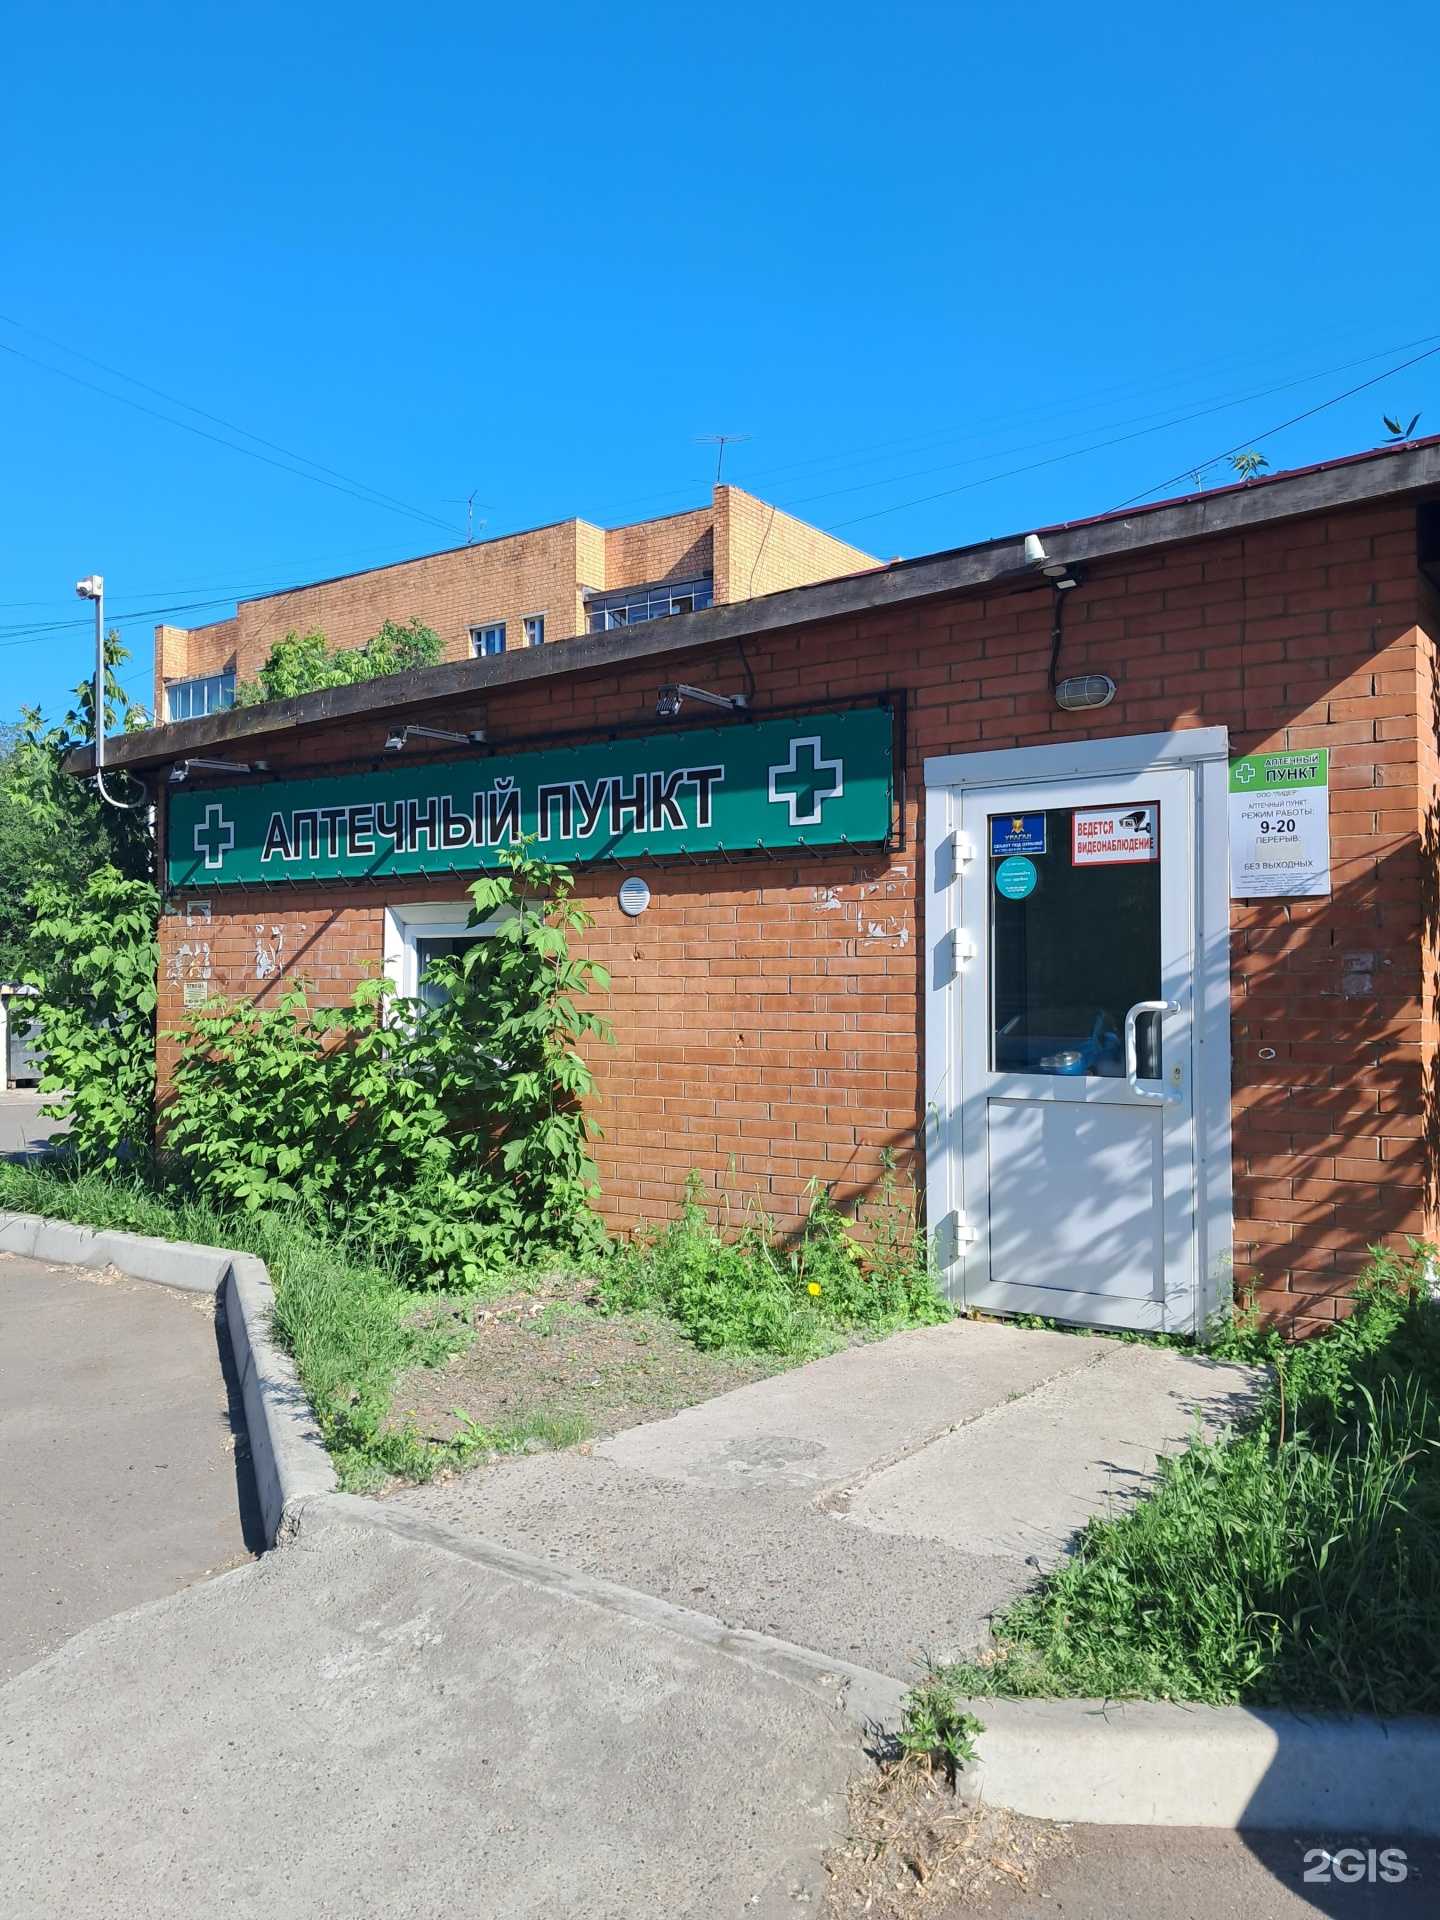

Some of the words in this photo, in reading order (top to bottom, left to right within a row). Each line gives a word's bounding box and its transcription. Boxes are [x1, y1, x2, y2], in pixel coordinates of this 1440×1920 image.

[1264, 754, 1319, 767] АПТЕЧНЫЙ
[1265, 767, 1318, 783] ПУНКТ
[1285, 799, 1307, 807] ПУНКТ
[261, 776, 522, 863] АПТЕЧНЫЙ
[537, 764, 726, 842] ПУНКТ
[1241, 810, 1274, 819] РЕЖИМ
[1077, 821, 1114, 837] ВЕДЕТСЯ
[1260, 818, 1296, 834] 9-20
[1077, 837, 1154, 856] ВИДЕОНАБЛЮДЕНИЕ
[1244, 862, 1260, 871] БЕЗ
[1262, 860, 1314, 870] ВЫХОДНЫХ
